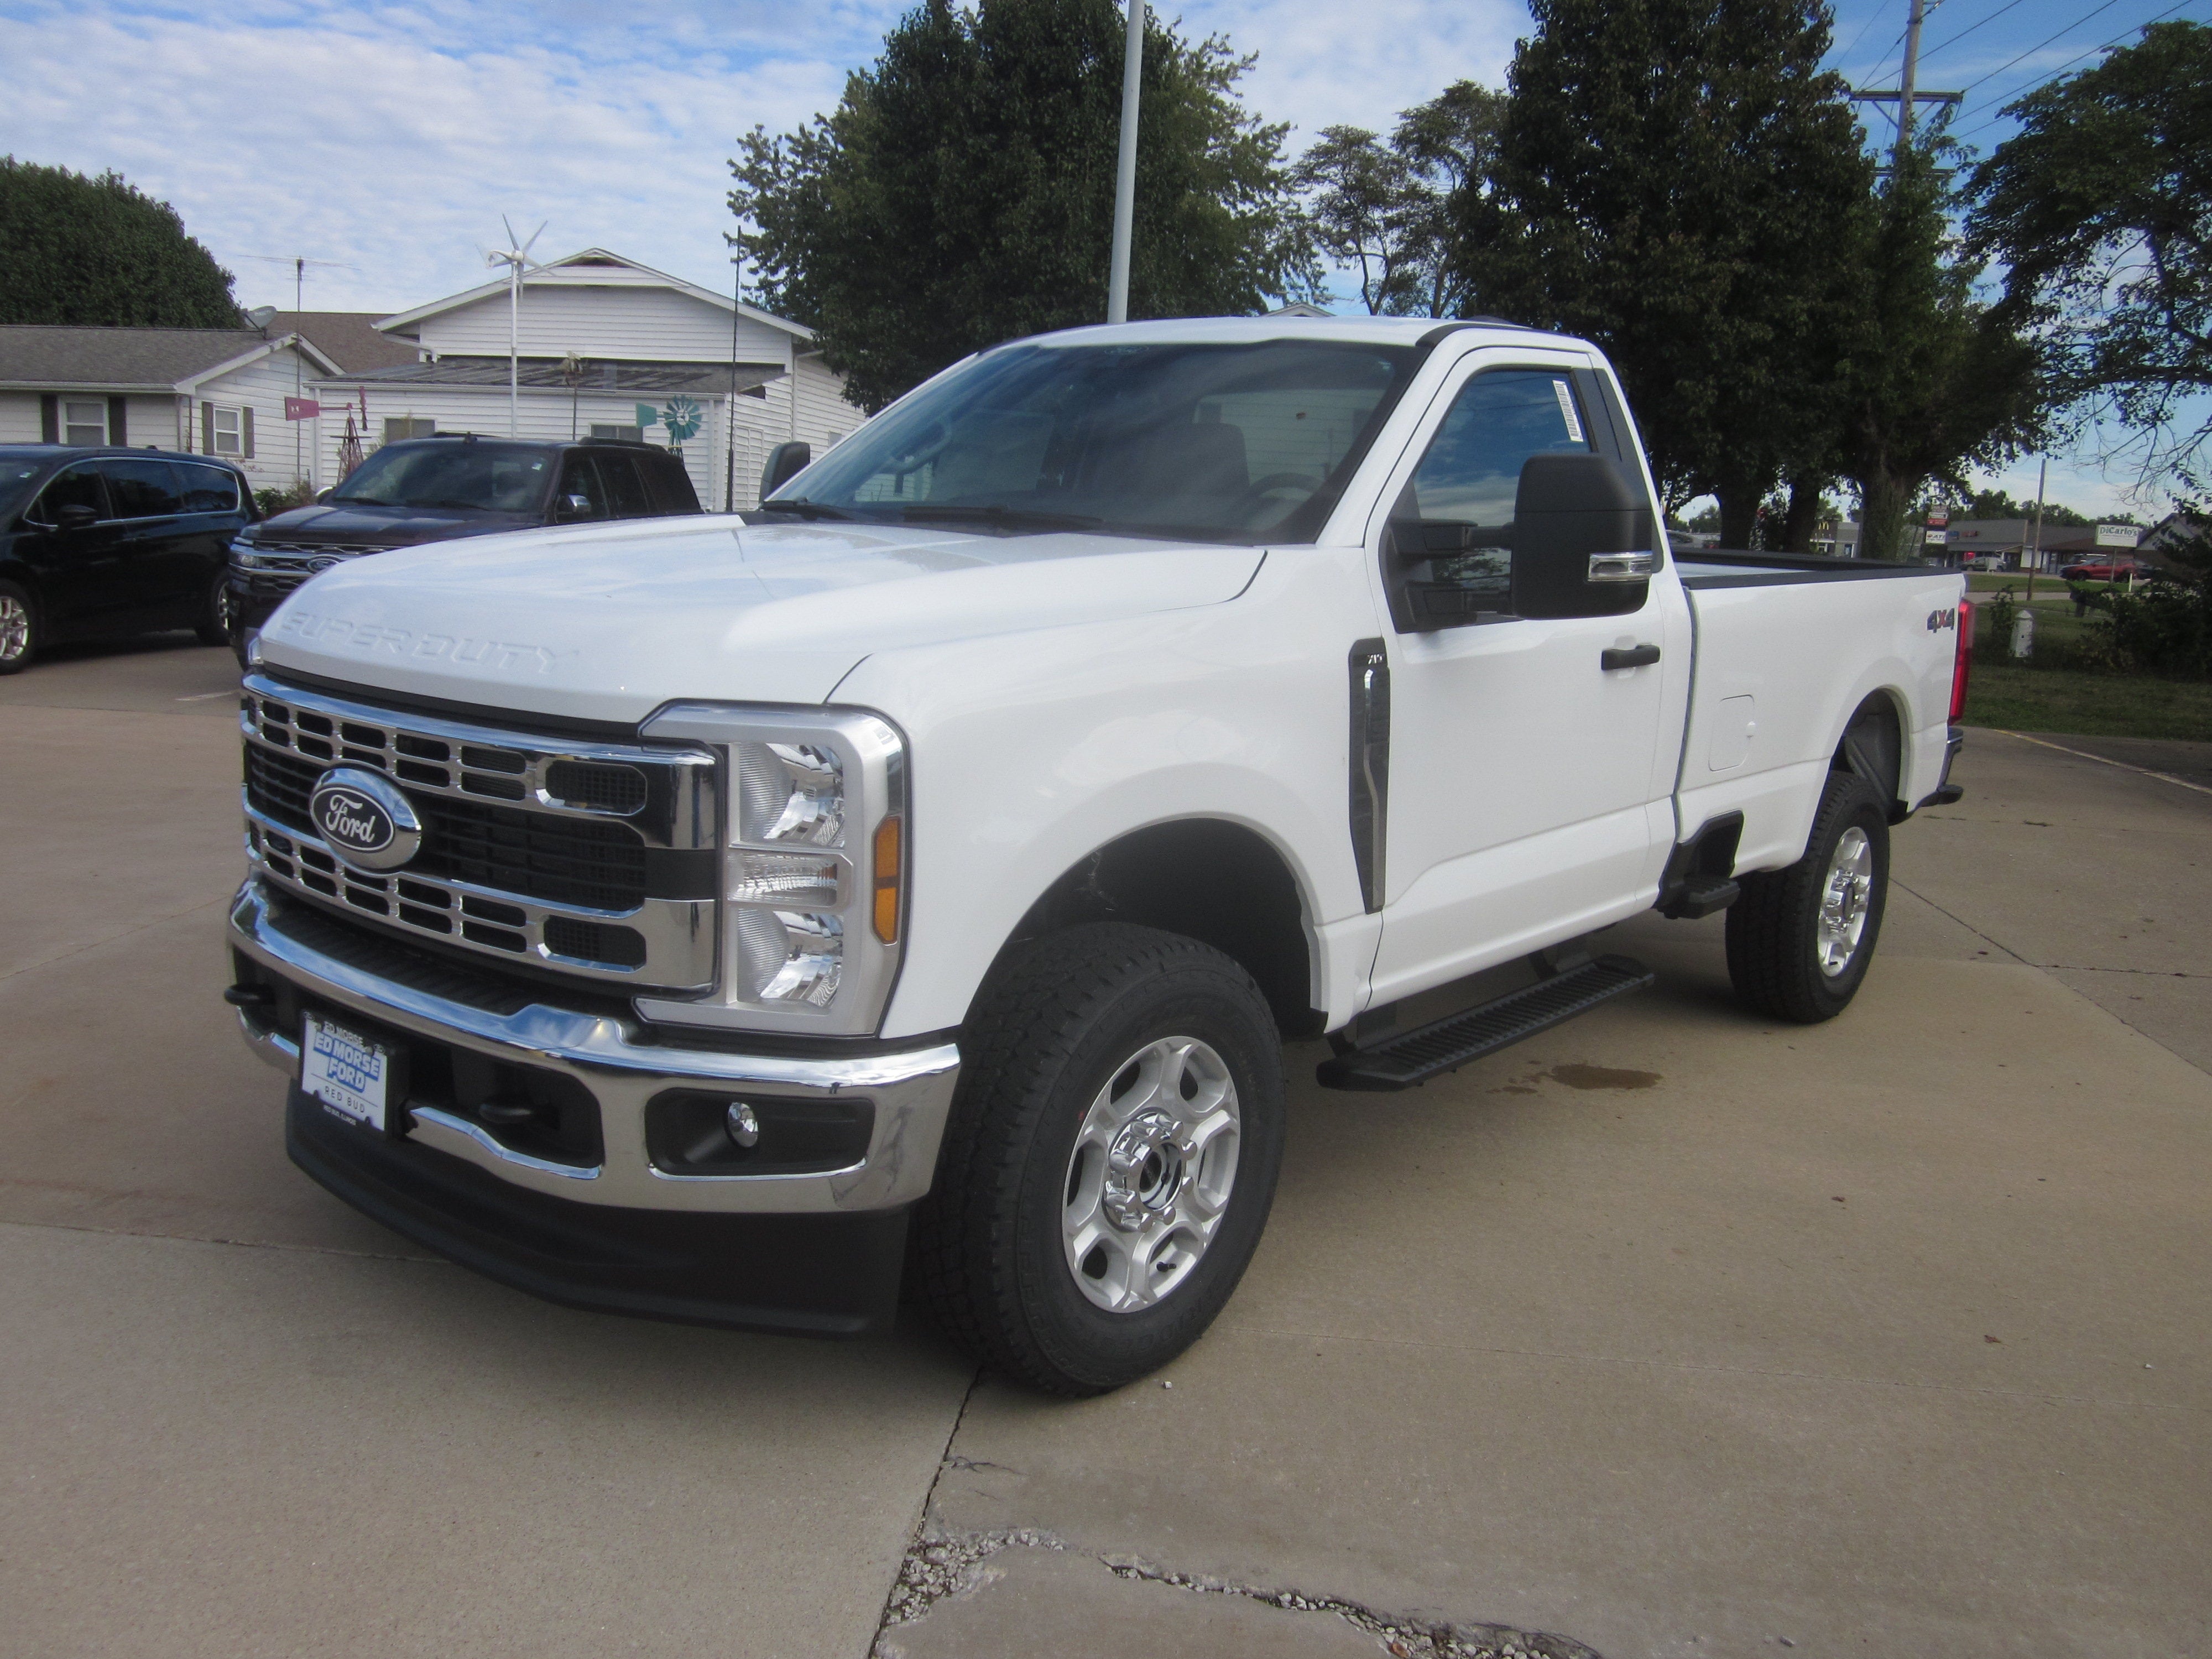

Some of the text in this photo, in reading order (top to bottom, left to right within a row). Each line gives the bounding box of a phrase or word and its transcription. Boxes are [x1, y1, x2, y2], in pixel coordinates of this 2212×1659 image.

[2100, 526, 2137, 536] DiCarlo's
[280, 612, 580, 675] SUPER DUTY
[326, 794, 375, 843] Ford
[314, 1032, 380, 1082] ED MORSE
[327, 1057, 366, 1093] FORD
[325, 1086, 366, 1113] RED BUD
